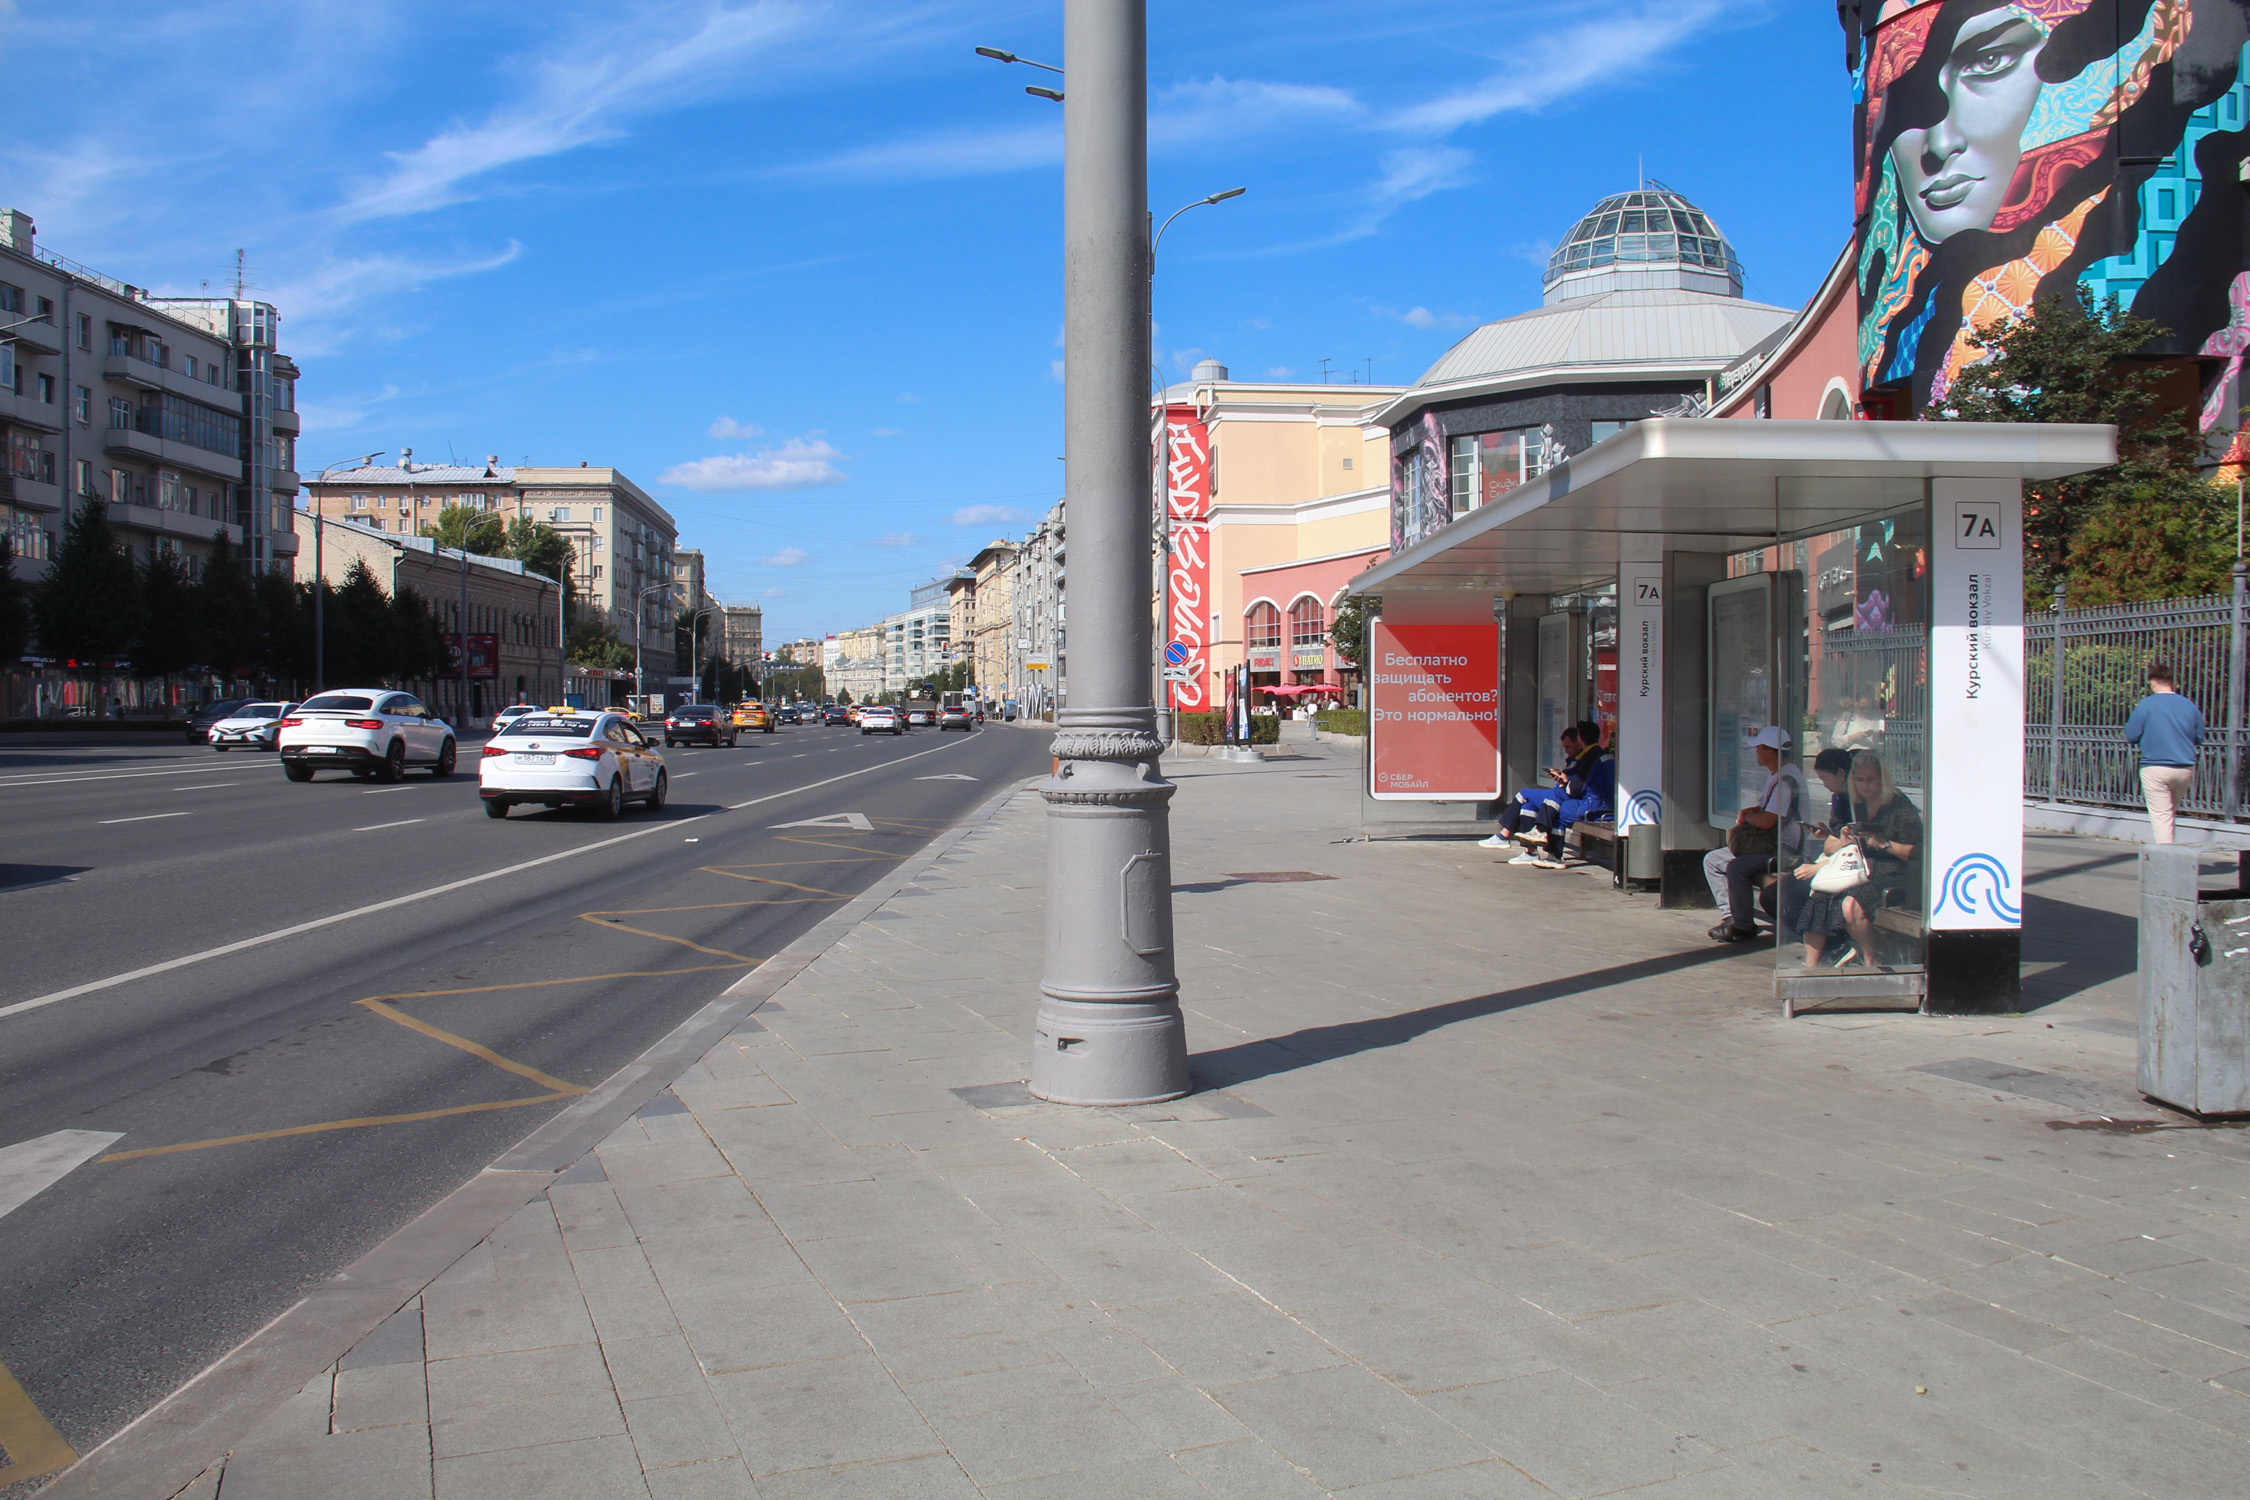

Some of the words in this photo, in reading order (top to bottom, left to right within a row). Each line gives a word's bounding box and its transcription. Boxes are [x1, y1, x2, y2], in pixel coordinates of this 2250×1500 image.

[1968, 574, 1979, 628] вокзал
[1982, 574, 1992, 608] Vokzal
[1641, 620, 1649, 654] вокзал
[1982, 610, 1993, 650] Kurskiy
[1385, 652, 1468, 666] Бесплатно
[1965, 633, 1981, 699] Курский
[1374, 673, 1452, 686] защищать
[1639, 656, 1650, 697] Курский
[1408, 688, 1498, 702] абонентов?
[1374, 708, 1403, 721] Это
[1407, 708, 1498, 724] нормально!
[1390, 773, 1413, 781] СБЕР
[1390, 780, 1429, 788] МОБАЙЛ
